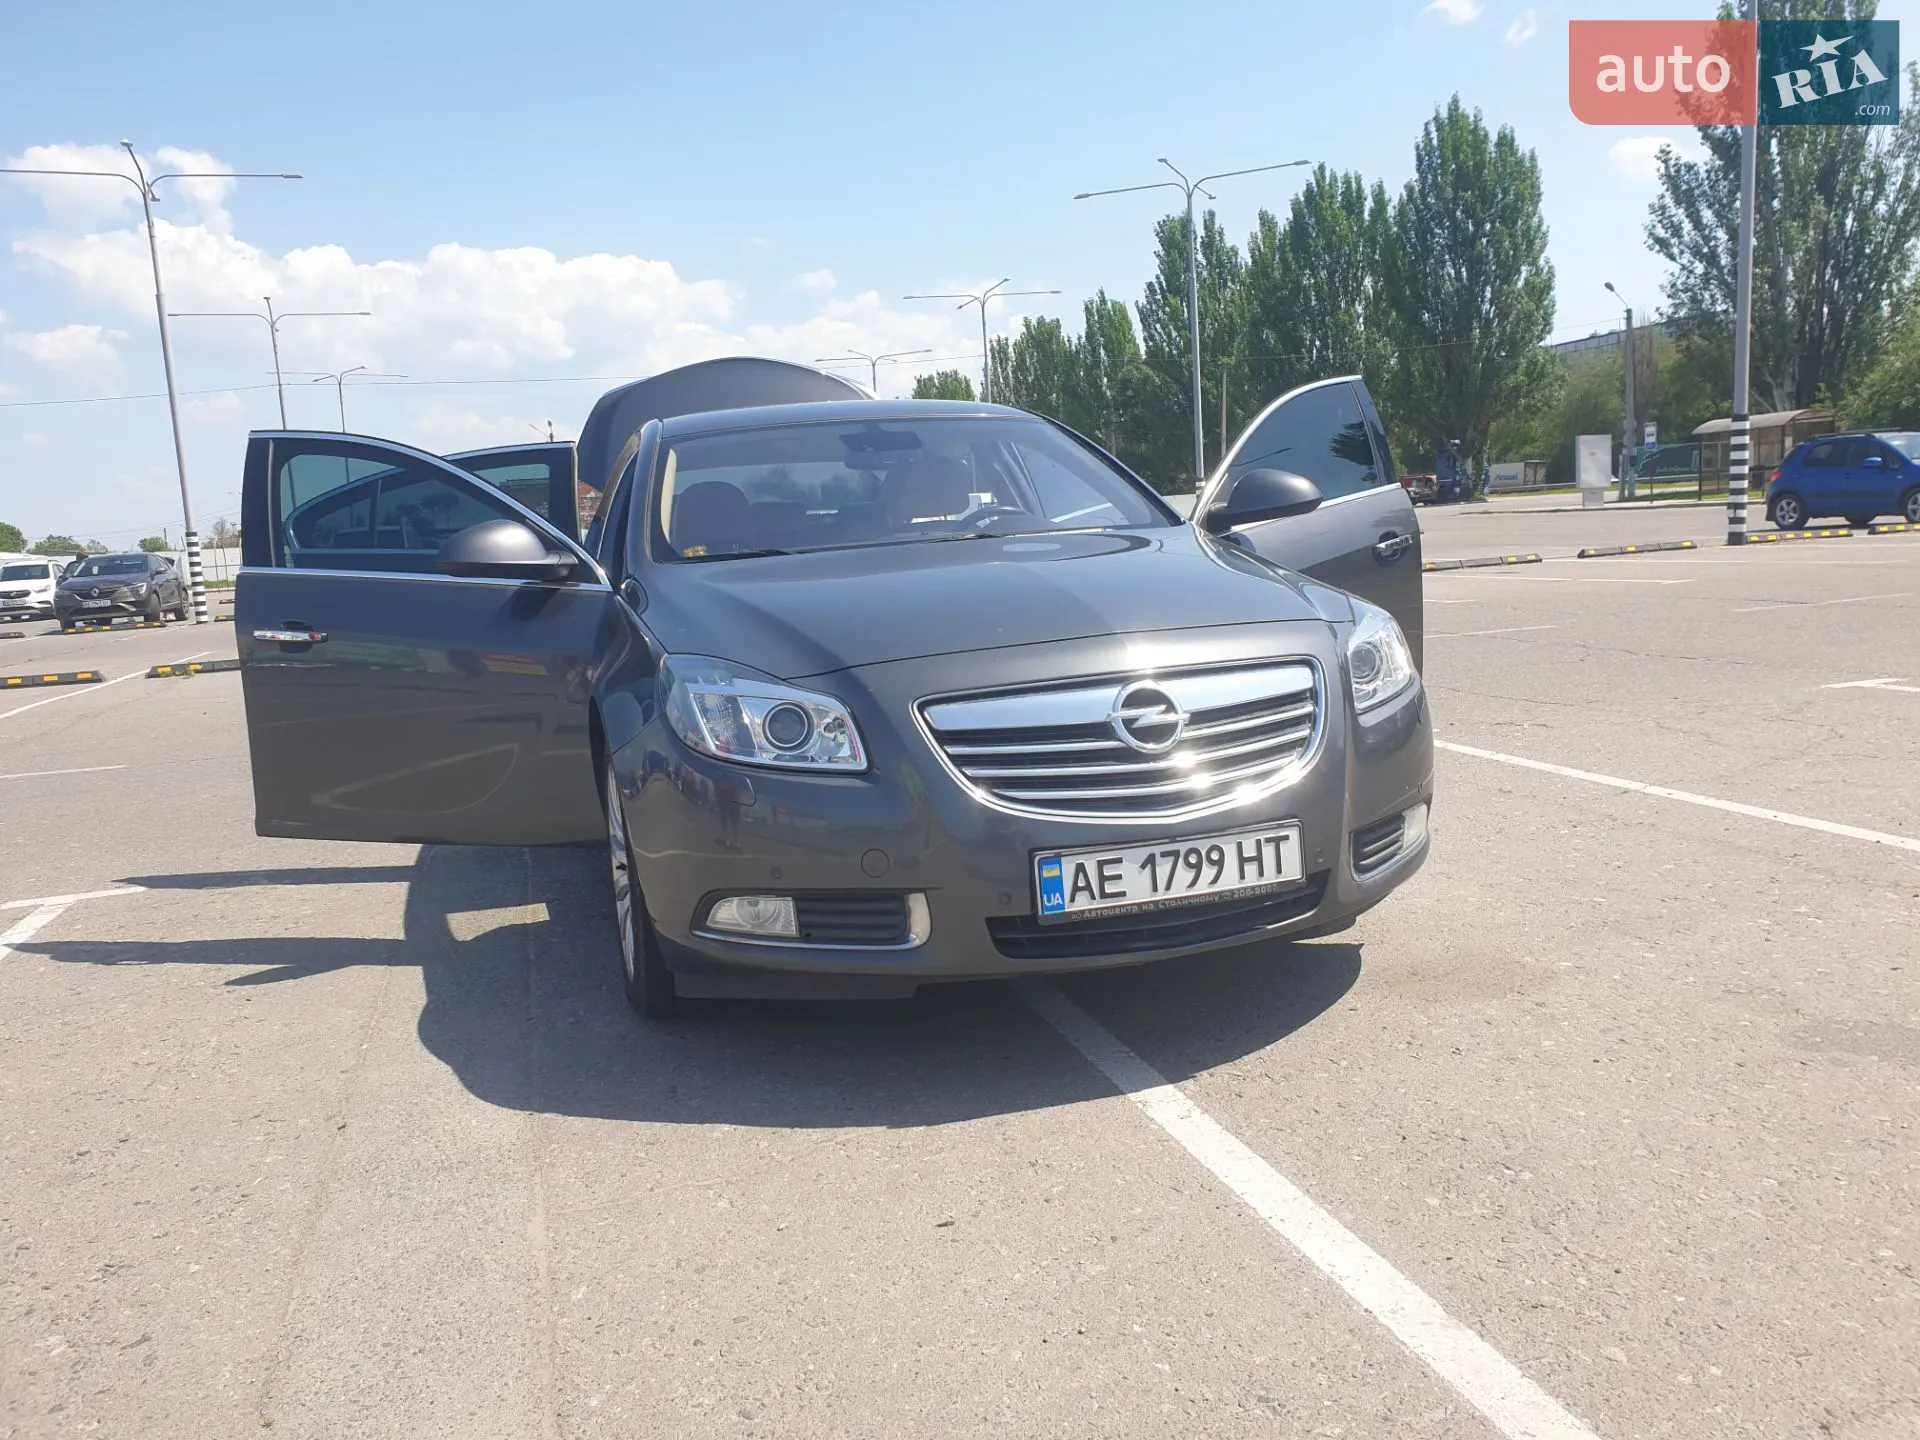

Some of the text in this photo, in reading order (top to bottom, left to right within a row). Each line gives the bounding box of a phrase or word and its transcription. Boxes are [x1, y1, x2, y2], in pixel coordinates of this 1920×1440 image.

[1069, 834, 1290, 904] AE 1799 HT
[1043, 893, 1063, 906] UA
